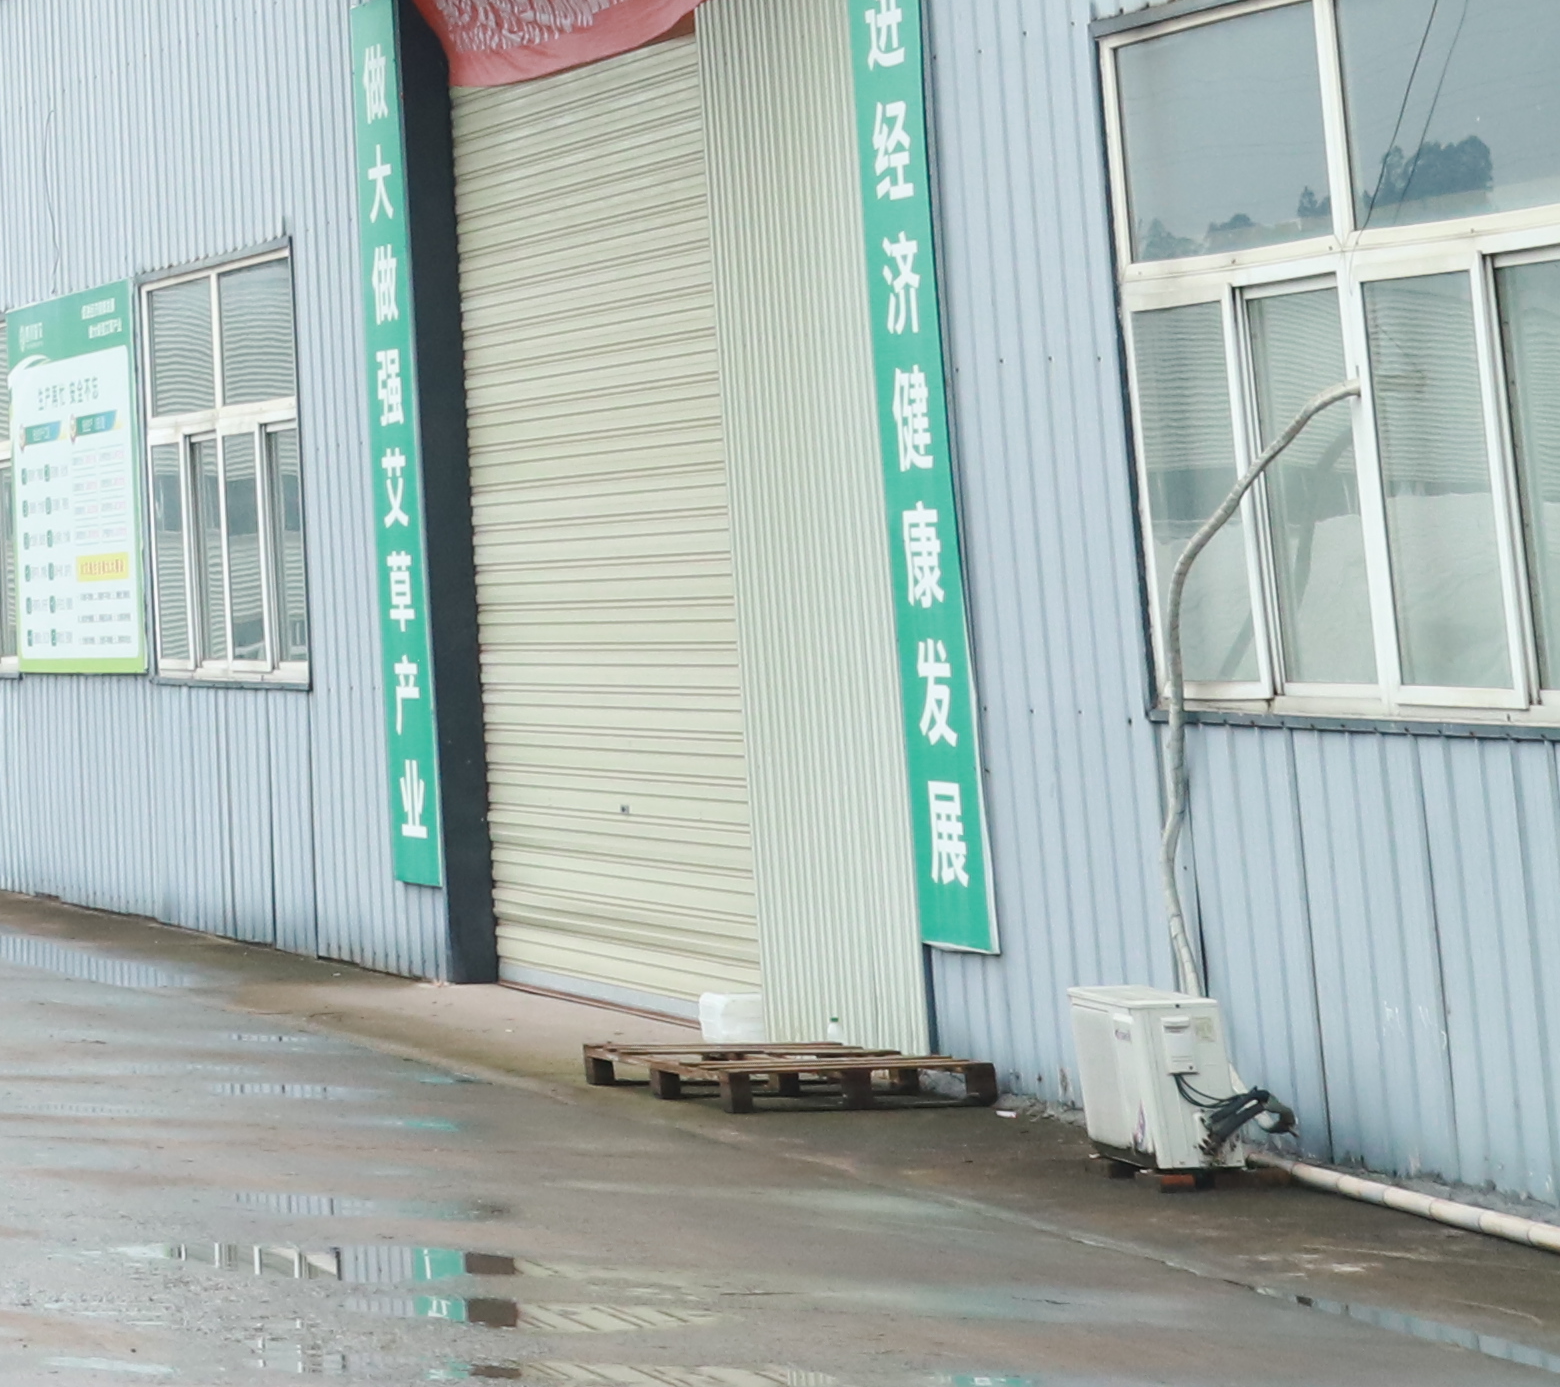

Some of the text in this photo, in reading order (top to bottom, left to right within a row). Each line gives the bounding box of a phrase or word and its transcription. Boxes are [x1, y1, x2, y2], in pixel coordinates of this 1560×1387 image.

[362, 43, 428, 840] 做大做强艾草产业
